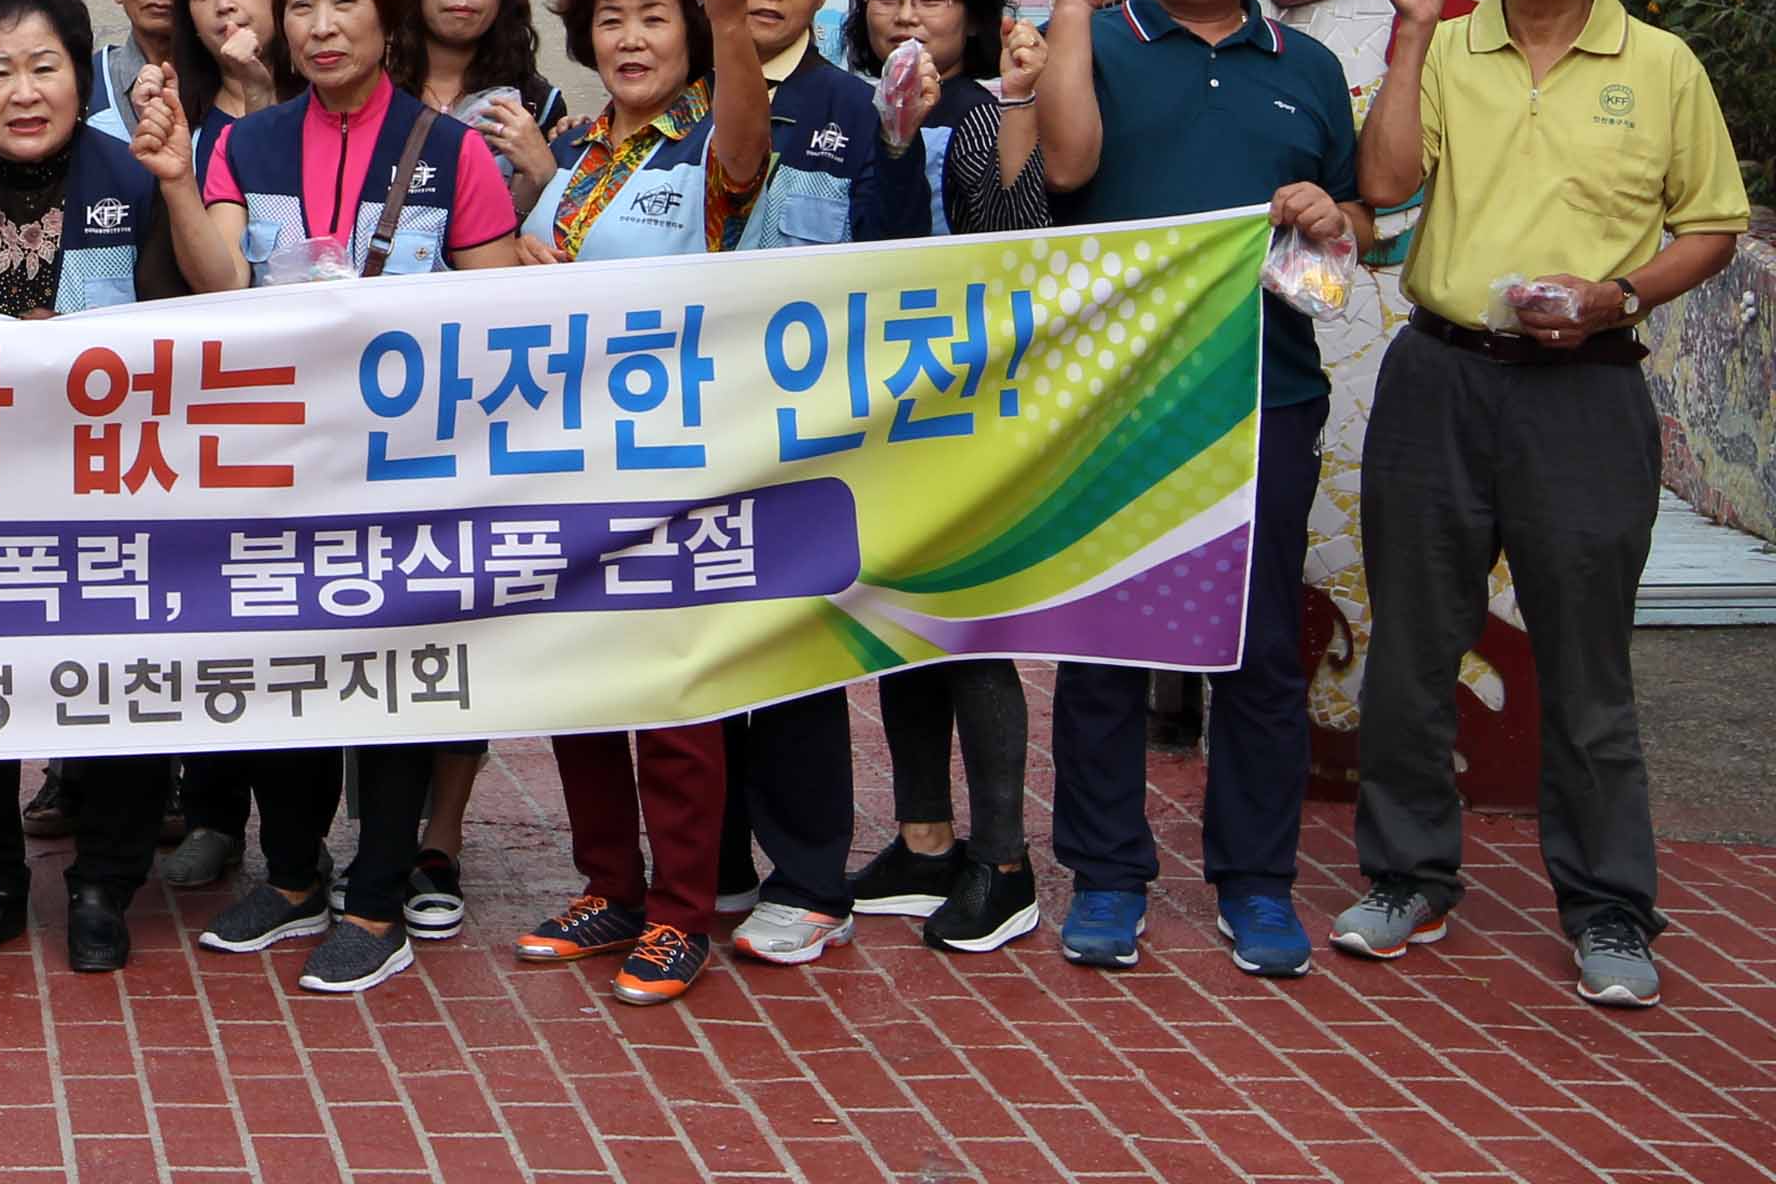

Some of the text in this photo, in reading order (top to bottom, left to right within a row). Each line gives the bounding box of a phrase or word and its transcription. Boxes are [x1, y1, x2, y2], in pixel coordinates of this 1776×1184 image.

[810, 130, 849, 152] KFF
[86, 205, 130, 226] KFF
[630, 192, 683, 214] KFF
[66, 338, 306, 496] 없는
[358, 304, 715, 483] 안전한
[764, 283, 1036, 463] 인천!
[220, 518, 569, 619] 불량식품
[598, 498, 758, 596] 근절
[49, 642, 472, 726] 인천동구지회
